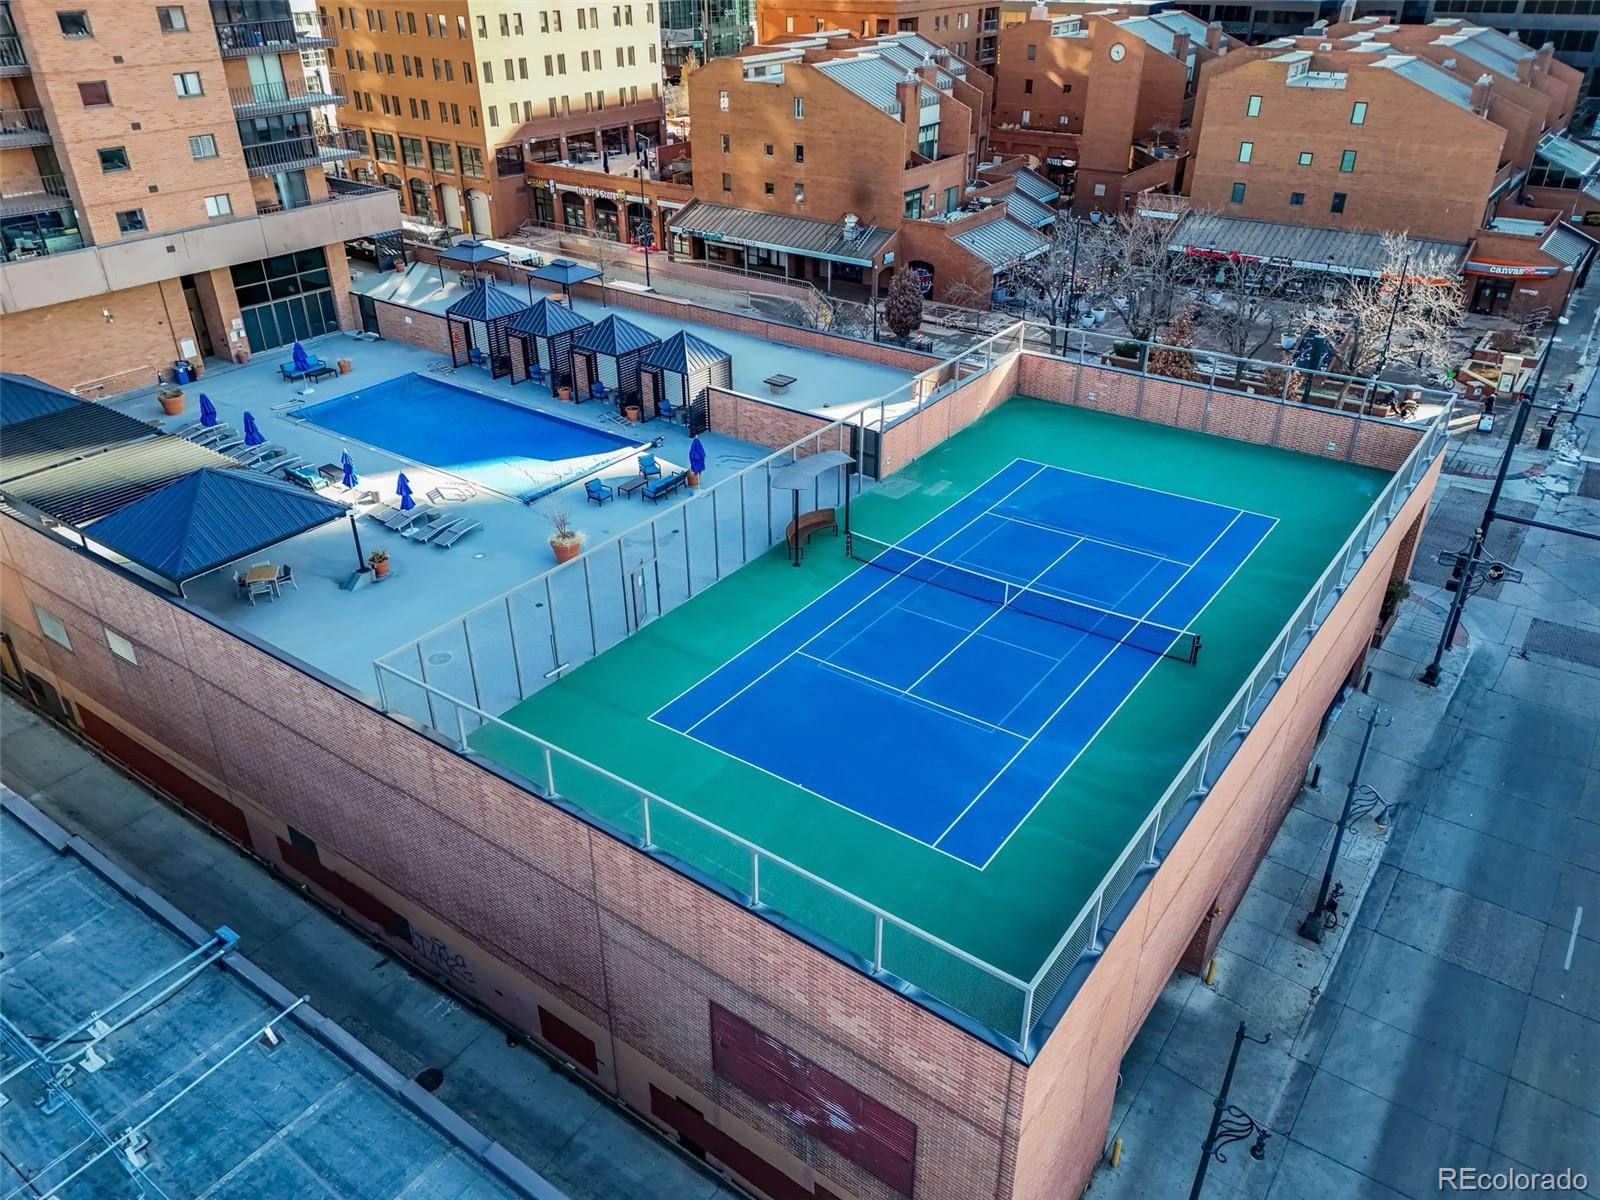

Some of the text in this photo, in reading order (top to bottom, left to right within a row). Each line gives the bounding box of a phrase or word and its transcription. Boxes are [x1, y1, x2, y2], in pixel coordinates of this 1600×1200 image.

[576, 186, 617, 200] The UPS Store
[1489, 266, 1524, 275] canvas
